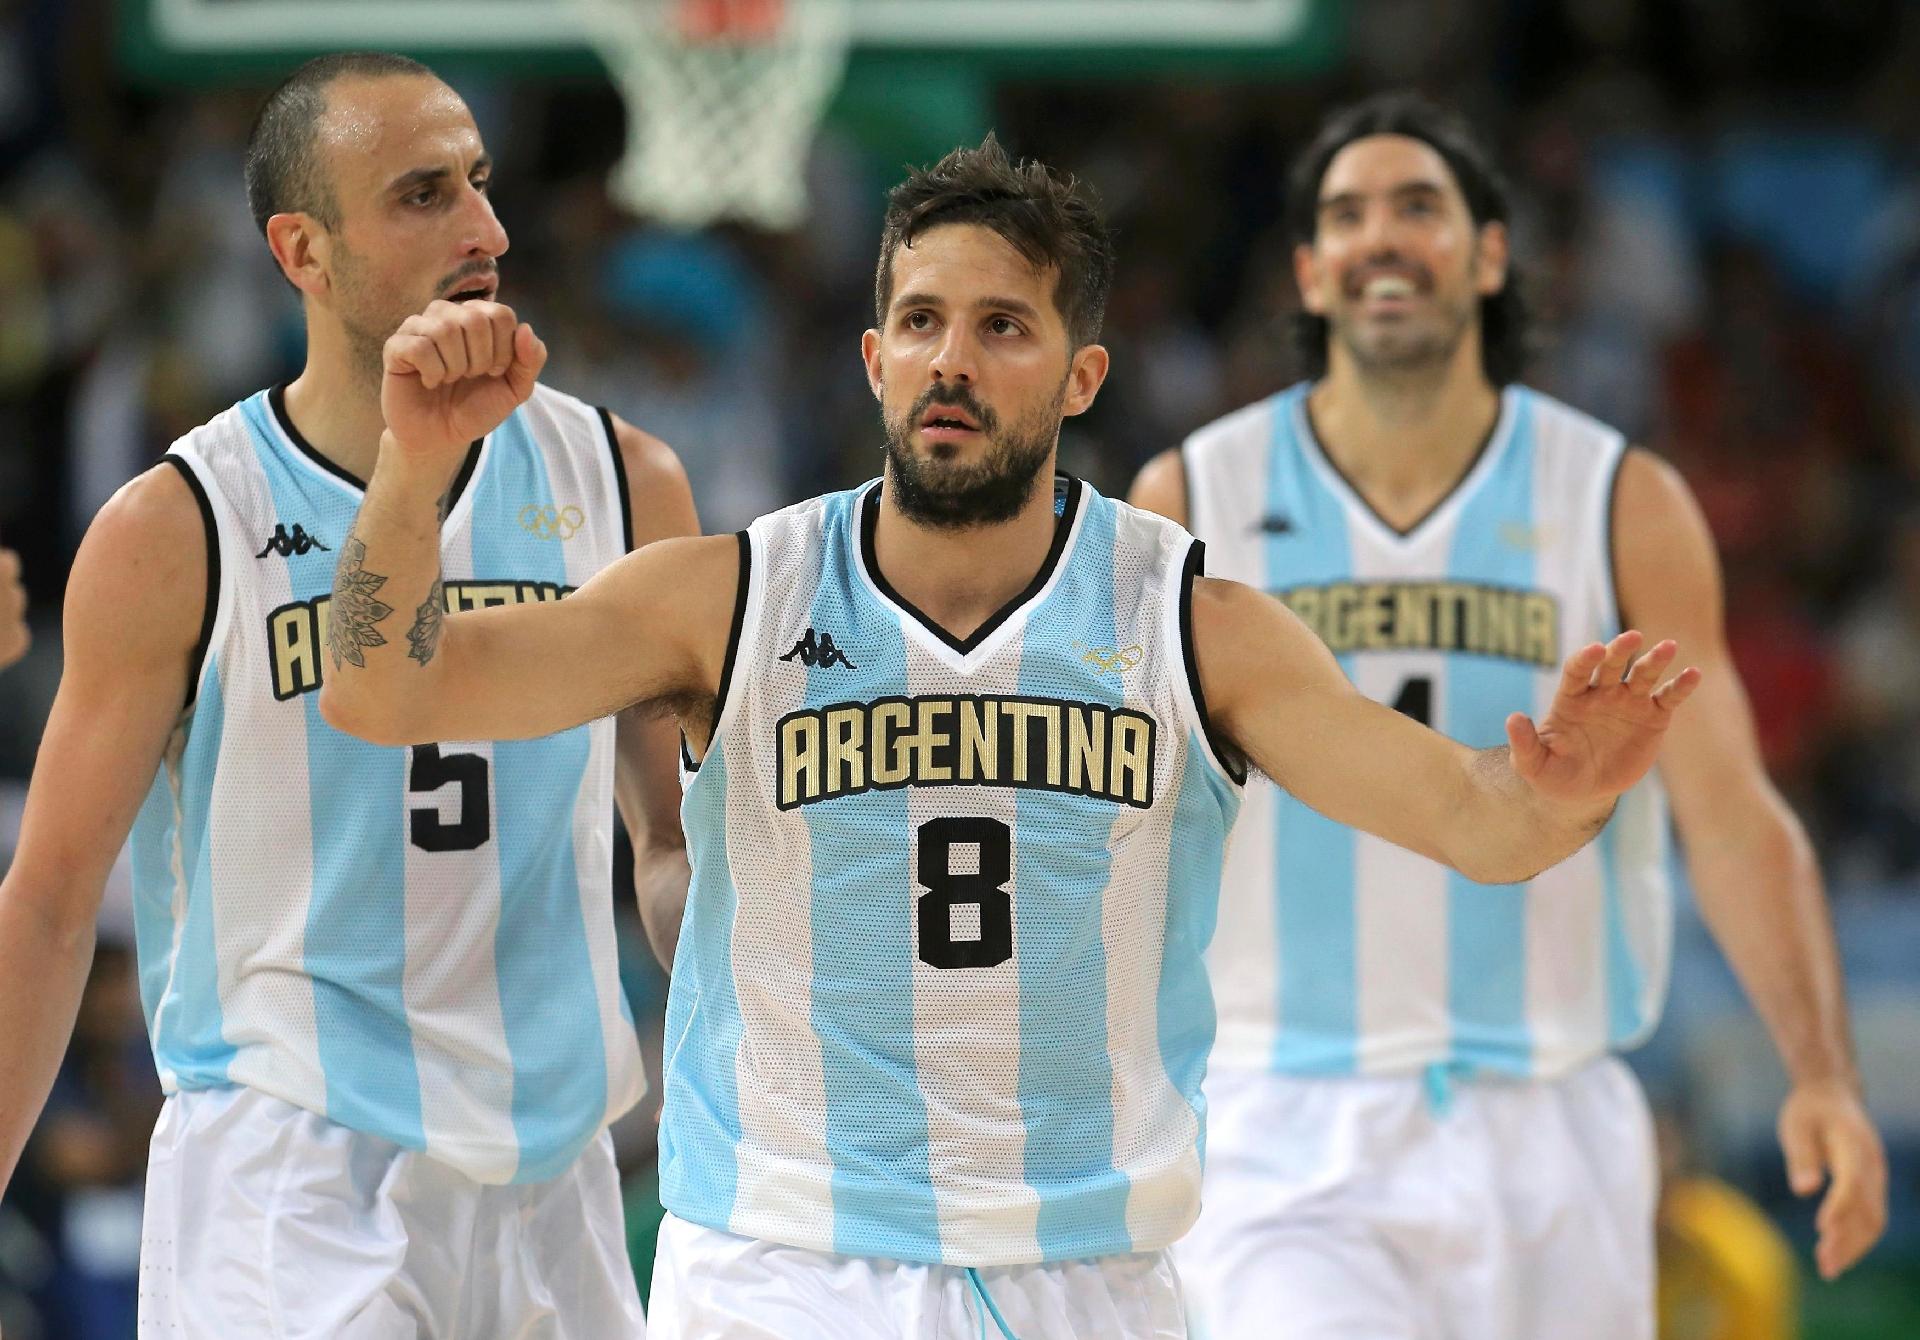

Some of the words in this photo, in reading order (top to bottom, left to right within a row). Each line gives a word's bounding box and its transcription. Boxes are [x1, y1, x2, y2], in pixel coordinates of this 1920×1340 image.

[409, 743, 490, 852] 5
[777, 695, 1156, 808] ARGENTINA
[917, 817, 1013, 969] 8
